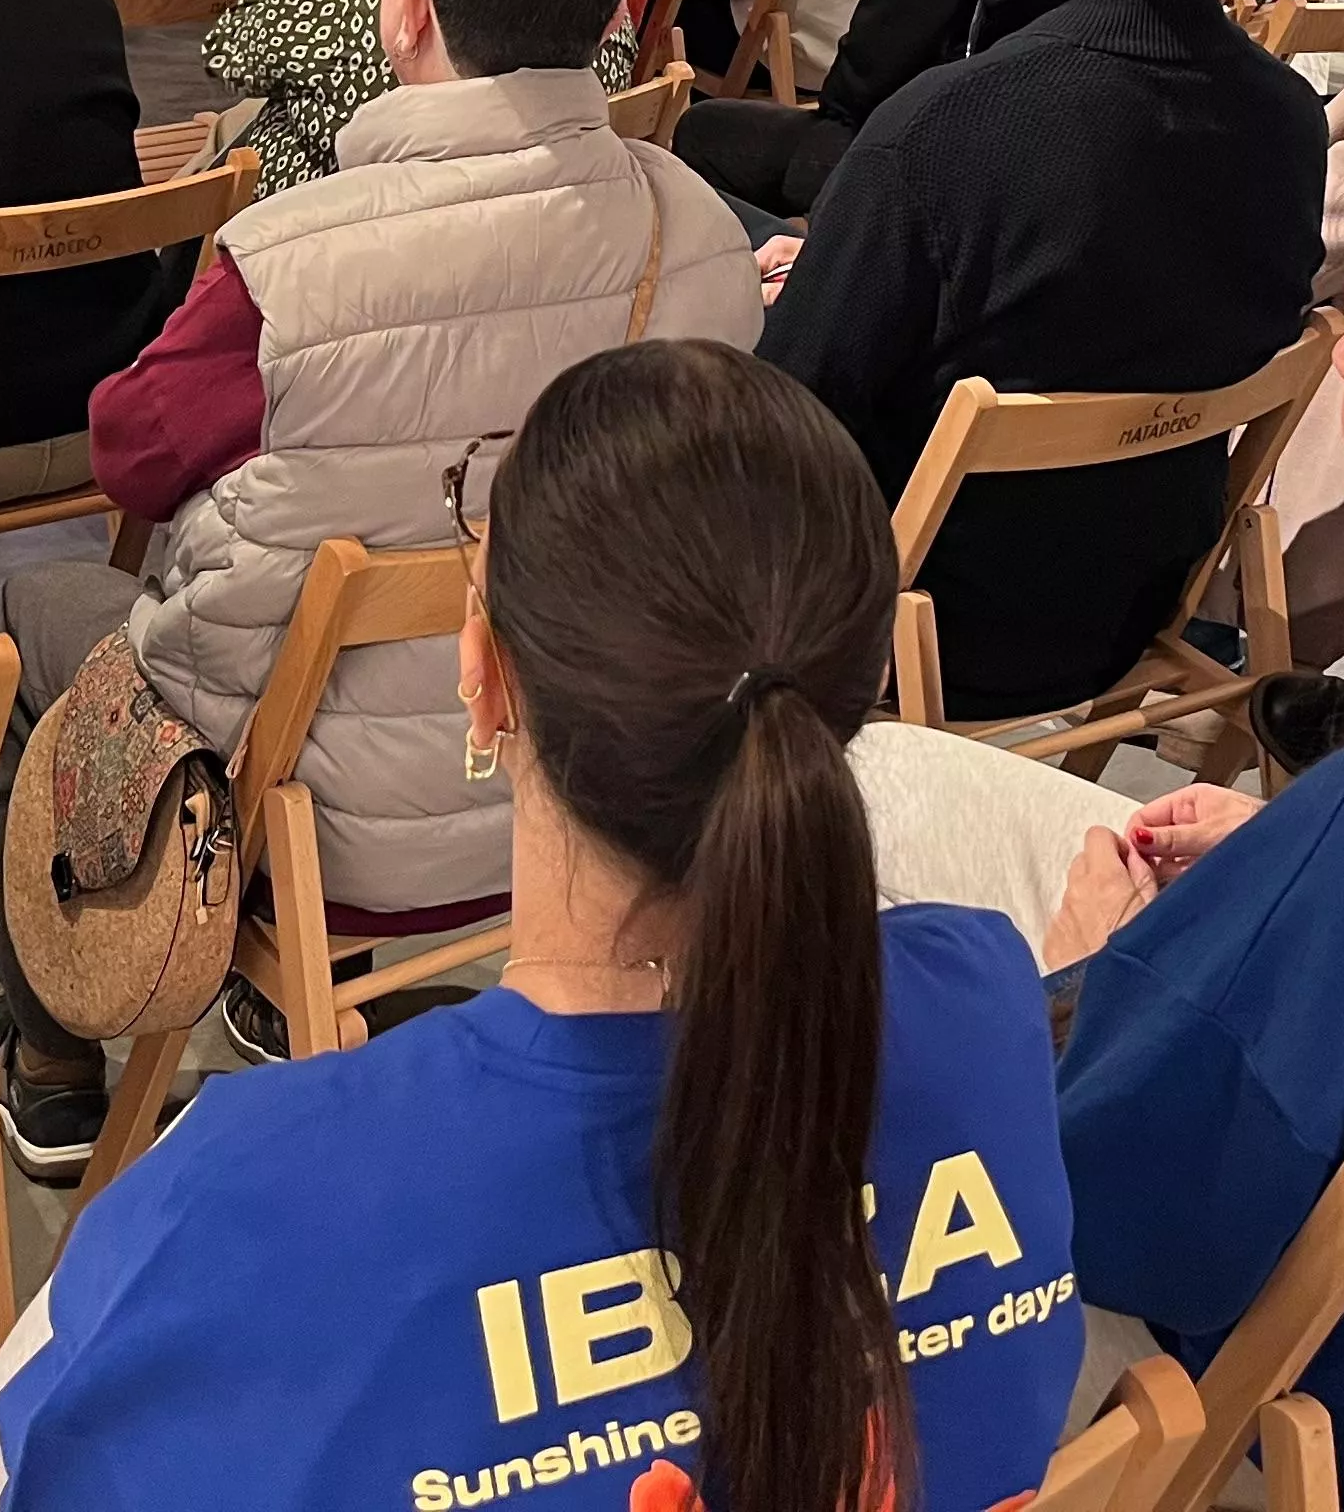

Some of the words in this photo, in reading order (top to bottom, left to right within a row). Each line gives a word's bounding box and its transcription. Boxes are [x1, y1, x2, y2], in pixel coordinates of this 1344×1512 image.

[1118, 412, 1200, 446] MATADERO
[988, 1270, 1076, 1337] days
[412, 1409, 701, 1512] Sunshine
